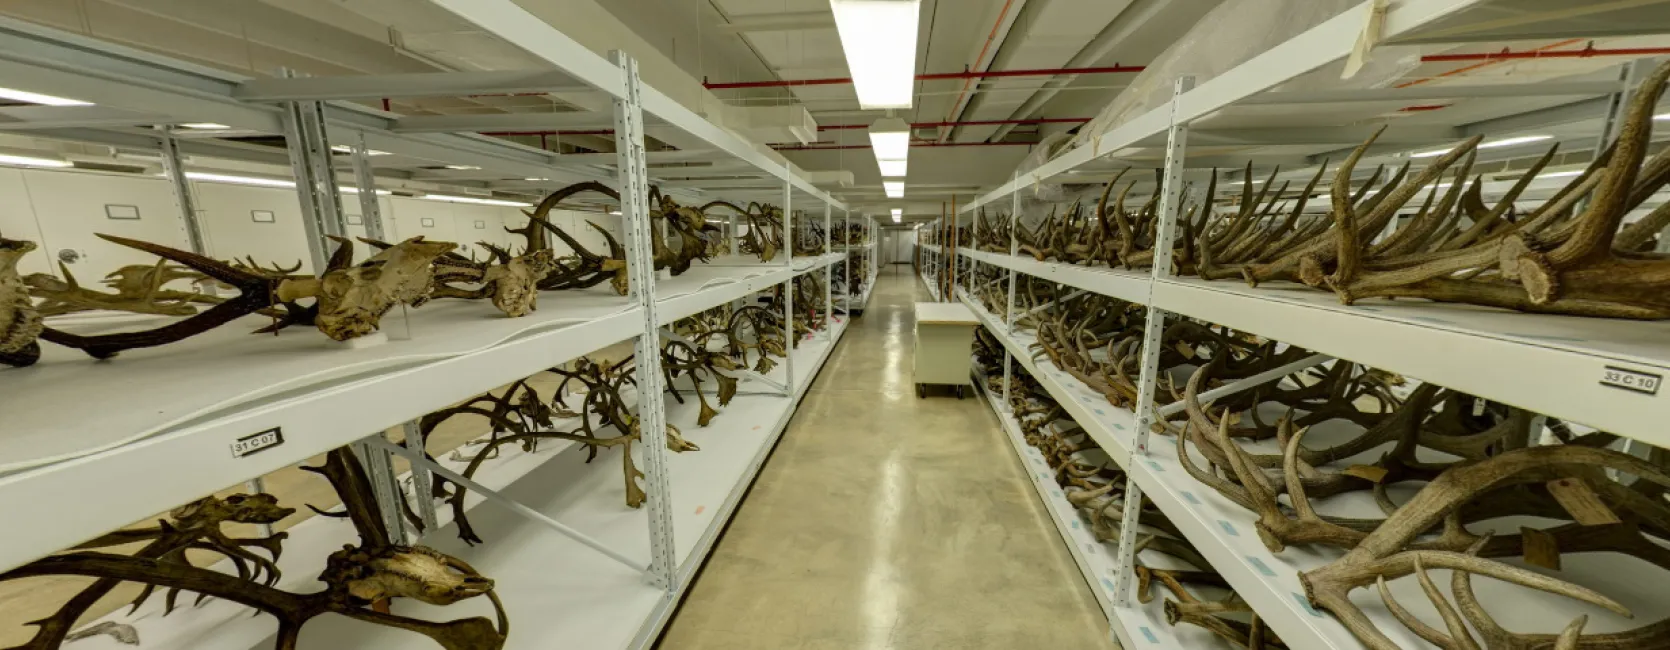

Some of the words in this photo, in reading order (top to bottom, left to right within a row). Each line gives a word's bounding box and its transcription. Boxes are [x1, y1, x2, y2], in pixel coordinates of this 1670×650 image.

[1604, 371, 1619, 382] 33
[1622, 374, 1634, 384] C
[1637, 378, 1653, 388] 10
[234, 442, 248, 452] 31
[250, 438, 259, 447] C
[261, 433, 274, 444] 07
